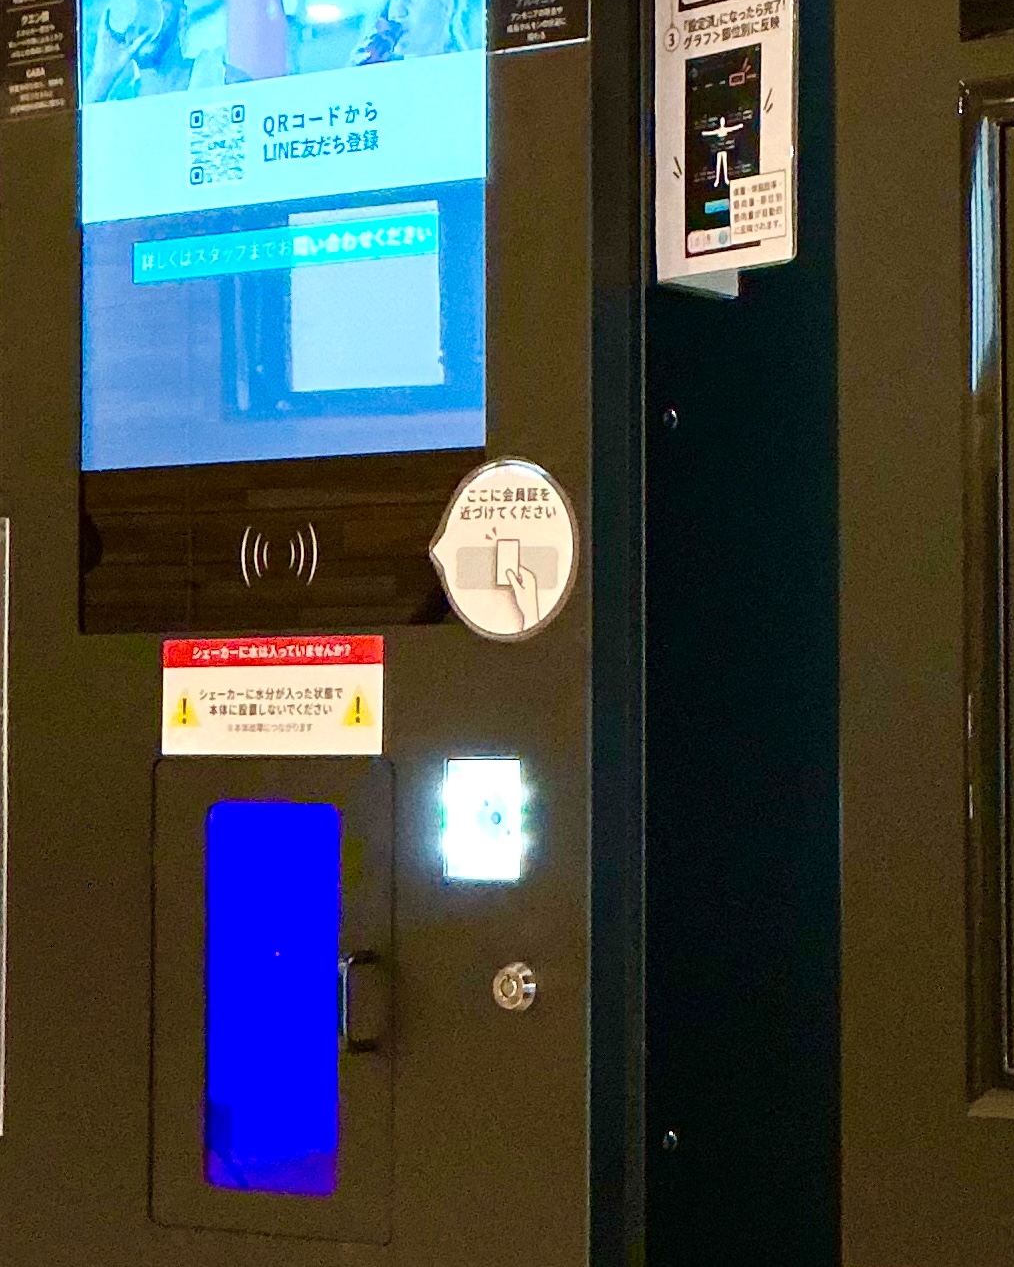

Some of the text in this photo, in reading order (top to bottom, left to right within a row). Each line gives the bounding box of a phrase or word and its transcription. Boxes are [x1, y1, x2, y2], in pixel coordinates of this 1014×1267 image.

[668, 33, 675, 47] 3
[263, 100, 379, 138] QRコードから
[263, 129, 380, 162] LINE友だち登録
[140, 224, 434, 271] 詳しくはスタッフまでお問い合わせください
[467, 487, 550, 502] ここに会員証を
[460, 506, 557, 520] 近づけてください
[192, 644, 352, 660] シェーカーに水は入っていませんか?
[199, 687, 343, 701] シェーカーに水分が入った状態で
[209, 703, 332, 717] 本体に設置しないでください
